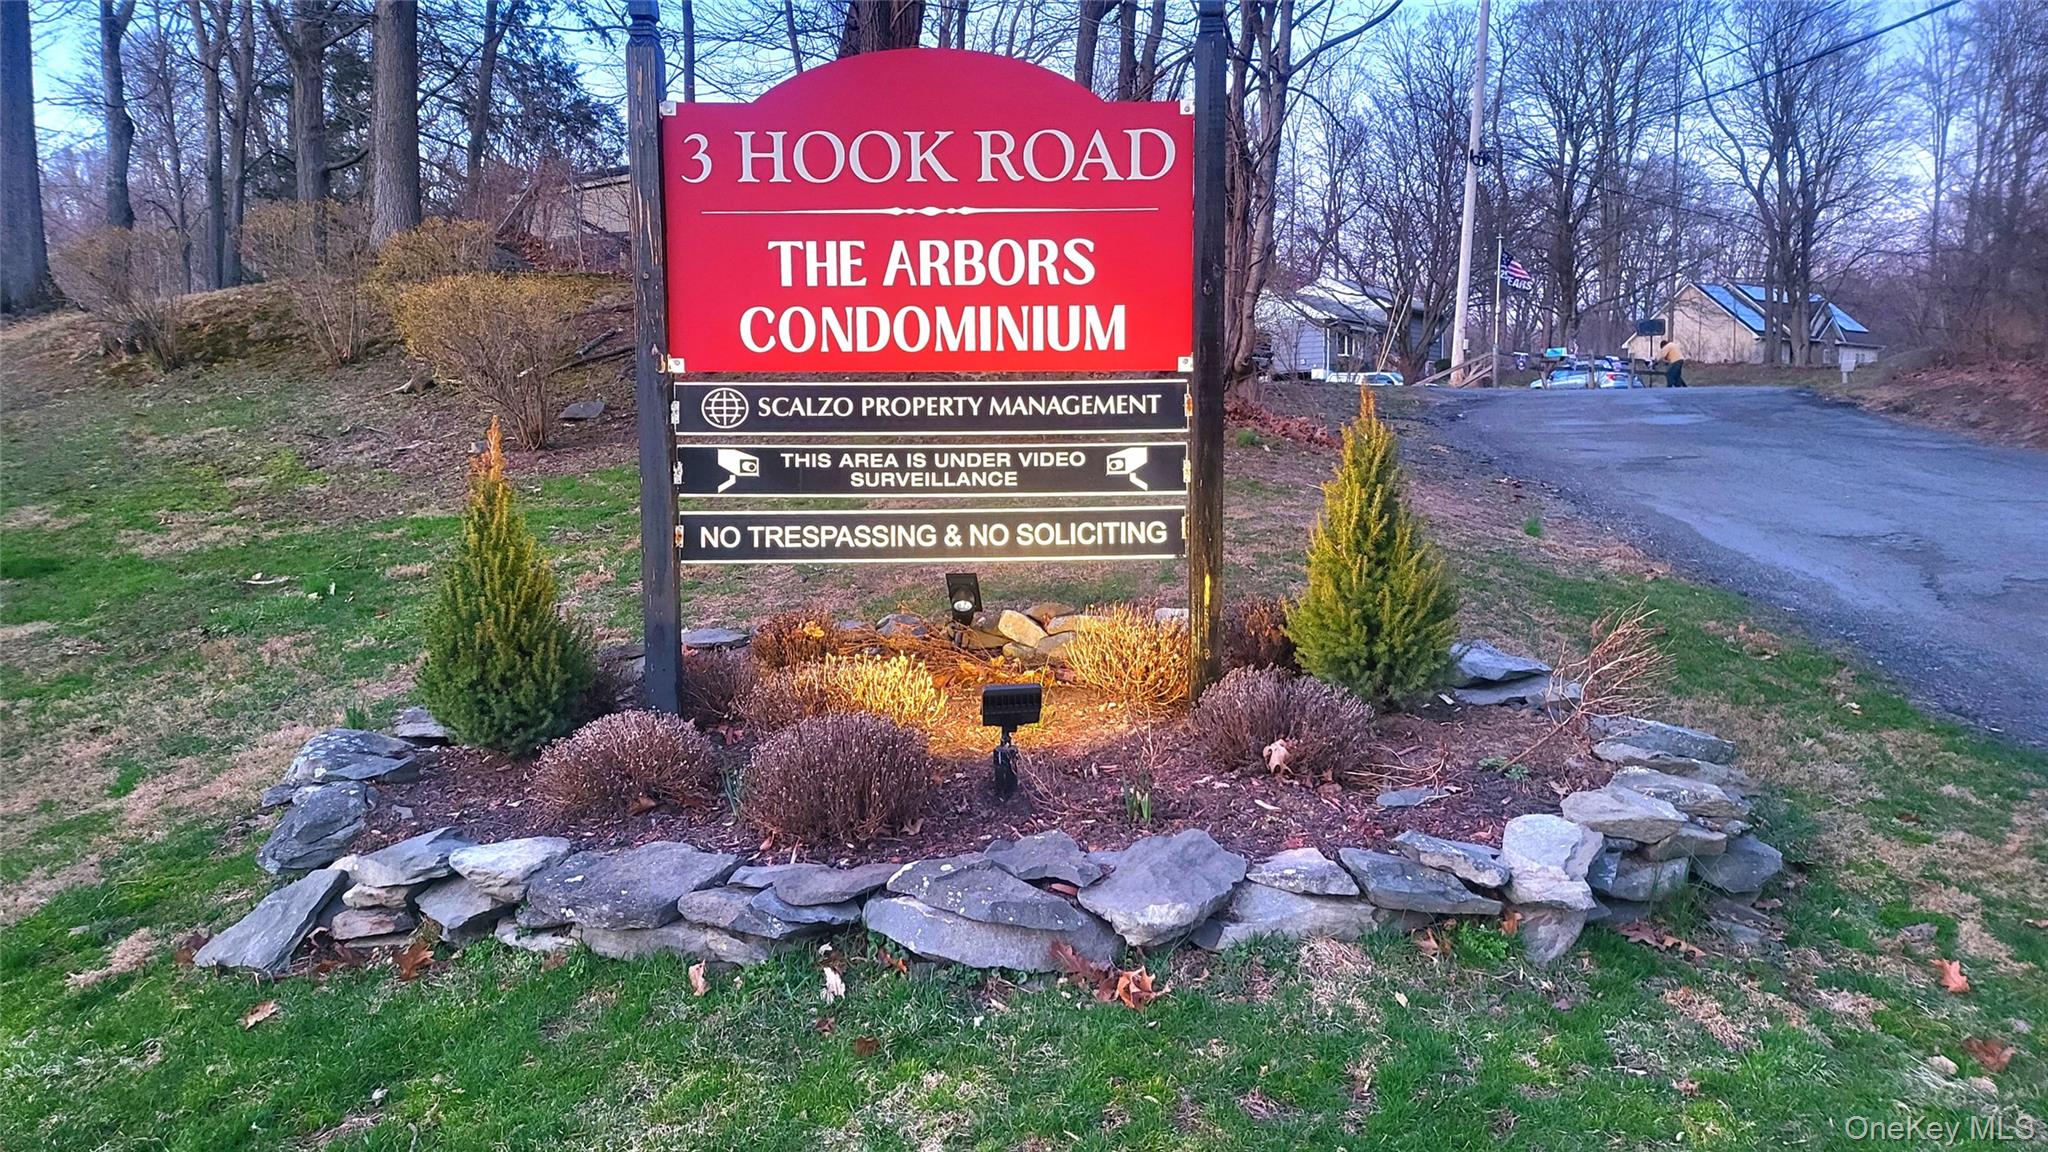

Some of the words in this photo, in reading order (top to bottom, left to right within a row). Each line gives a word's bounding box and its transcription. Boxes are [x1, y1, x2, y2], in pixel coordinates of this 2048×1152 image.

[681, 133, 713, 184] 3
[733, 130, 959, 184] HOOK
[973, 128, 1177, 183] ROAD
[767, 240, 868, 287] THE
[882, 237, 1096, 287] ARBORS
[739, 304, 1127, 353] CONDOMINIUM
[758, 396, 854, 417] SCALZO
[861, 396, 984, 417] PROPERTY
[989, 394, 1162, 416] MANAGEMENT
[780, 453, 832, 469] THIS
[838, 453, 899, 468] AREA
[906, 452, 927, 468] IS
[934, 452, 1012, 468] UNDER
[1018, 451, 1087, 467] VIDEO
[850, 470, 1018, 488] SURVEILLANCE
[700, 525, 741, 549] NO
[746, 524, 937, 549] TRESPASSING
[943, 523, 964, 548] &
[969, 523, 1010, 547] NO
[1015, 520, 1168, 547] SOLICITING
